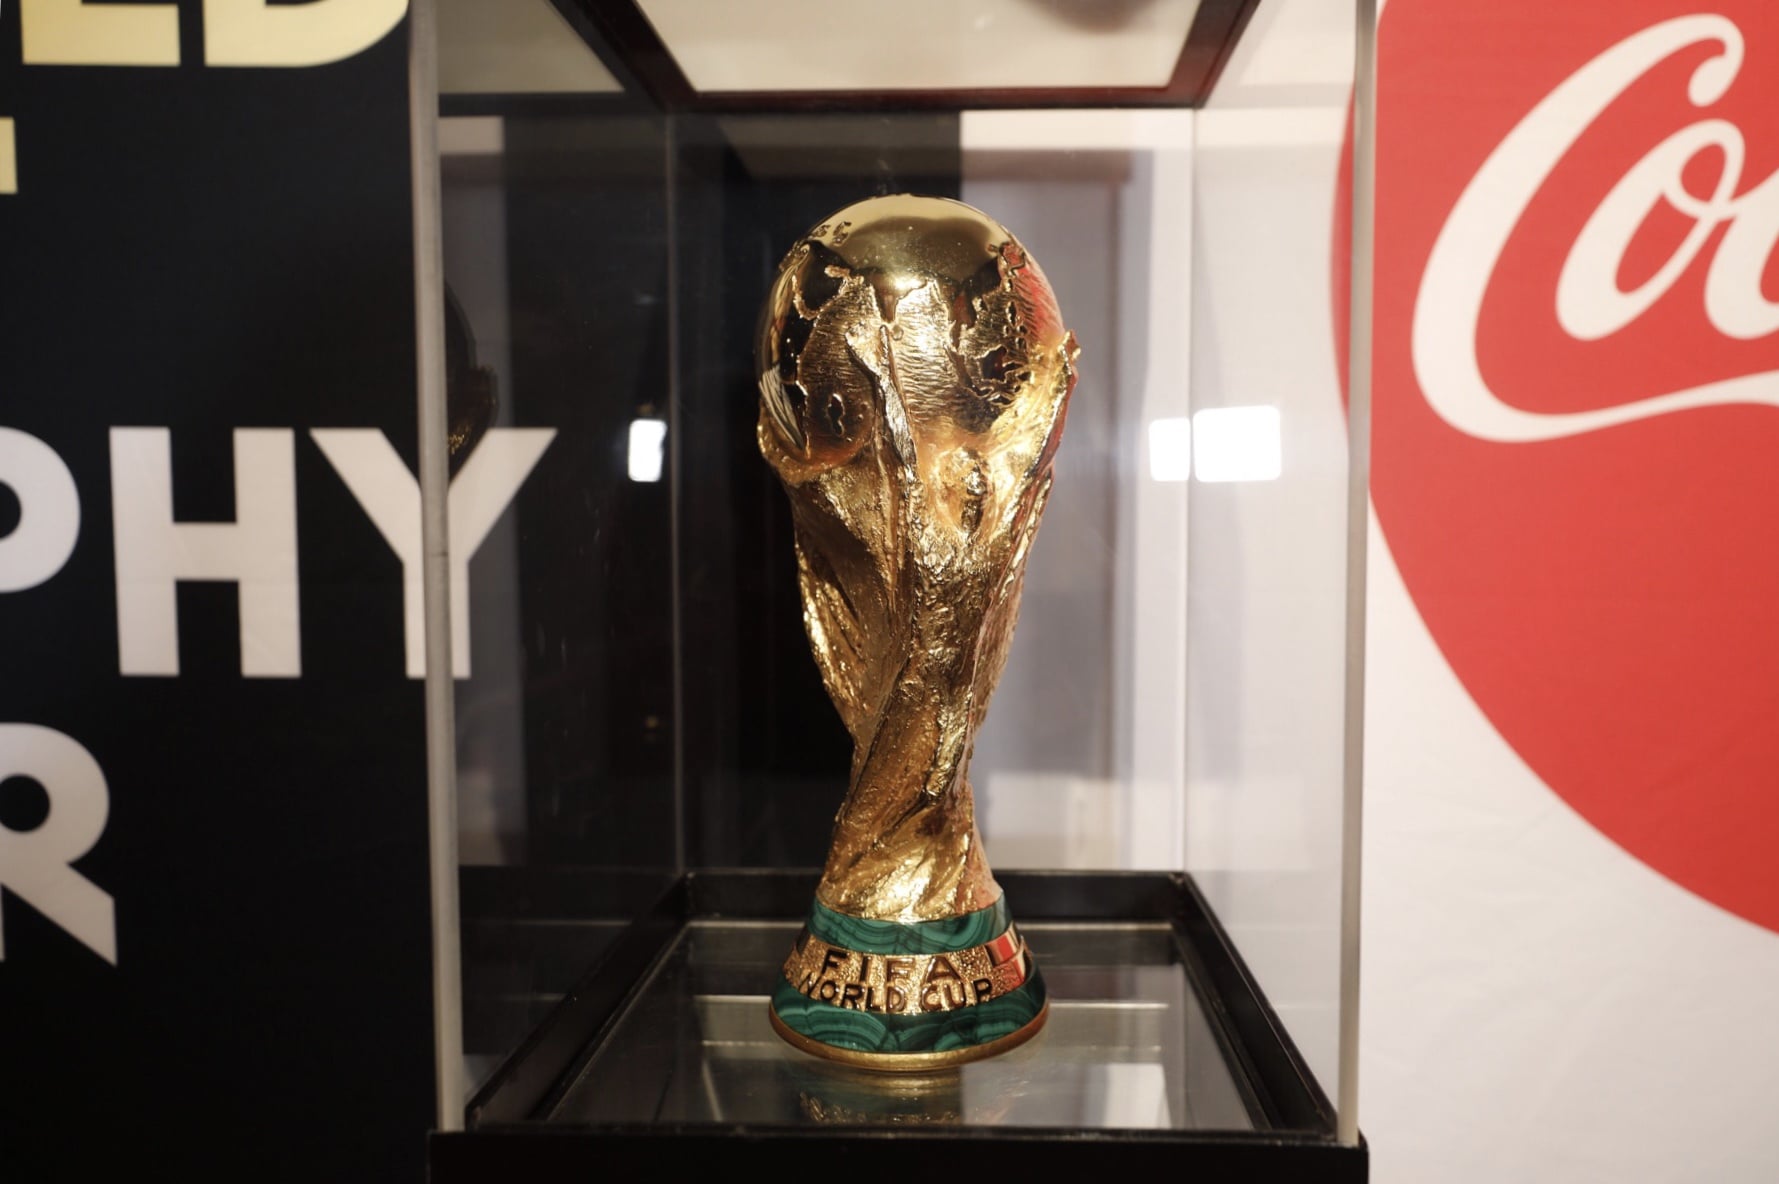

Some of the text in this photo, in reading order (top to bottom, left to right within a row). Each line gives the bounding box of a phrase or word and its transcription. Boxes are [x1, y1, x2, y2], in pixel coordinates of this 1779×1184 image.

[821, 949, 962, 982] FIFA
[798, 971, 993, 1012] WORLD CUP
